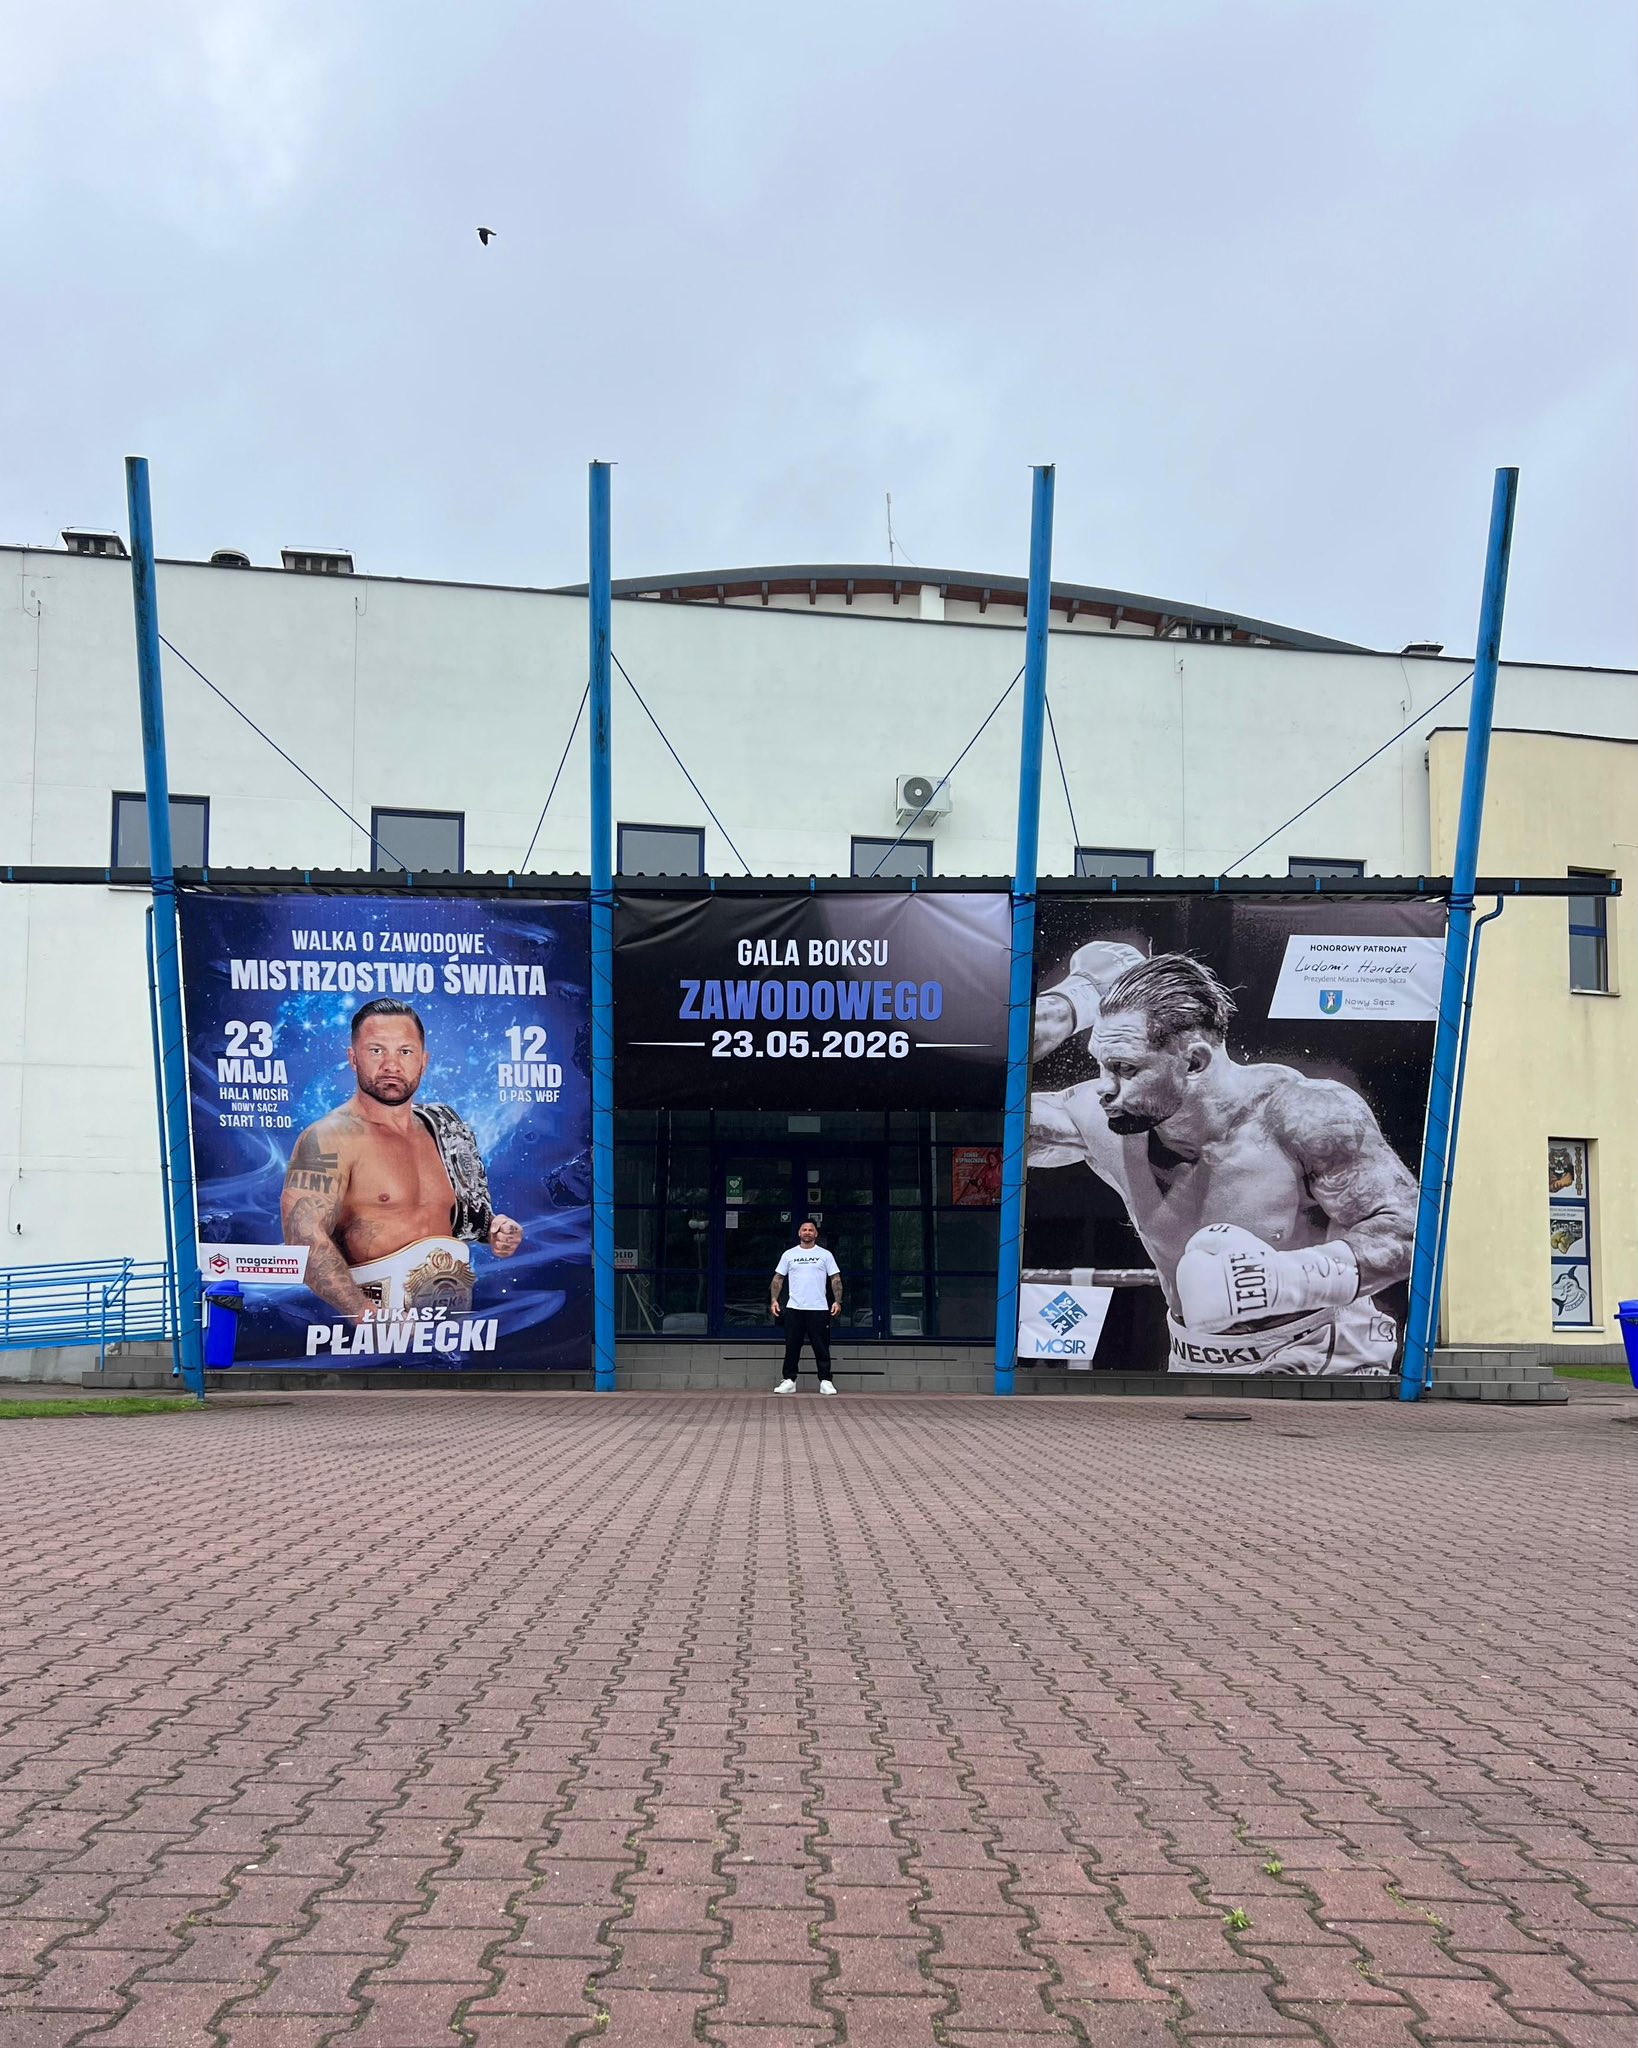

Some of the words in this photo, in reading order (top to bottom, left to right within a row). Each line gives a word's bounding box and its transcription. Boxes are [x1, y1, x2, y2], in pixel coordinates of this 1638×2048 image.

[292, 929, 357, 951] WALKA
[362, 931, 374, 952] O
[380, 931, 485, 954] ZAWODOWE
[1310, 944, 1361, 952] HONOROWY
[1363, 945, 1407, 953] PATRONAT
[737, 938, 800, 966] GALA
[808, 939, 889, 967] BOKSU
[1295, 956, 1349, 972] Ludomir
[1358, 960, 1417, 974] Handzel
[230, 959, 435, 994] MISTRZOSTWO
[443, 953, 547, 996] ŚWIATA
[1304, 975, 1336, 983] Prezydent
[1360, 976, 1388, 984] Nowego
[1388, 976, 1407, 984] Sącza
[678, 979, 943, 1021] ZAWODOWEGO
[1344, 998, 1370, 1007] Nowy
[1373, 998, 1395, 1007] Sącz
[224, 1020, 274, 1058] 23
[505, 1025, 547, 1062] 12
[711, 1030, 910, 1059] 23.05.2026
[217, 1058, 288, 1084] MAJA
[498, 1063, 563, 1088] RUND
[219, 1087, 250, 1100] HALA
[252, 1088, 289, 1101] MOSIR
[500, 1089, 507, 1102] O
[510, 1090, 532, 1102] PAS
[535, 1090, 560, 1103] WBF
[231, 1102, 256, 1112] NOWY
[257, 1103, 278, 1114] SĄCZ
[219, 1114, 254, 1127] START
[258, 1115, 292, 1128] 18:00
[236, 1256, 298, 1266] magazimm
[362, 1306, 448, 1323] ŁUKASZ
[306, 1319, 498, 1356] PŁAWECKI
[1035, 1338, 1086, 1355] MOSIR
